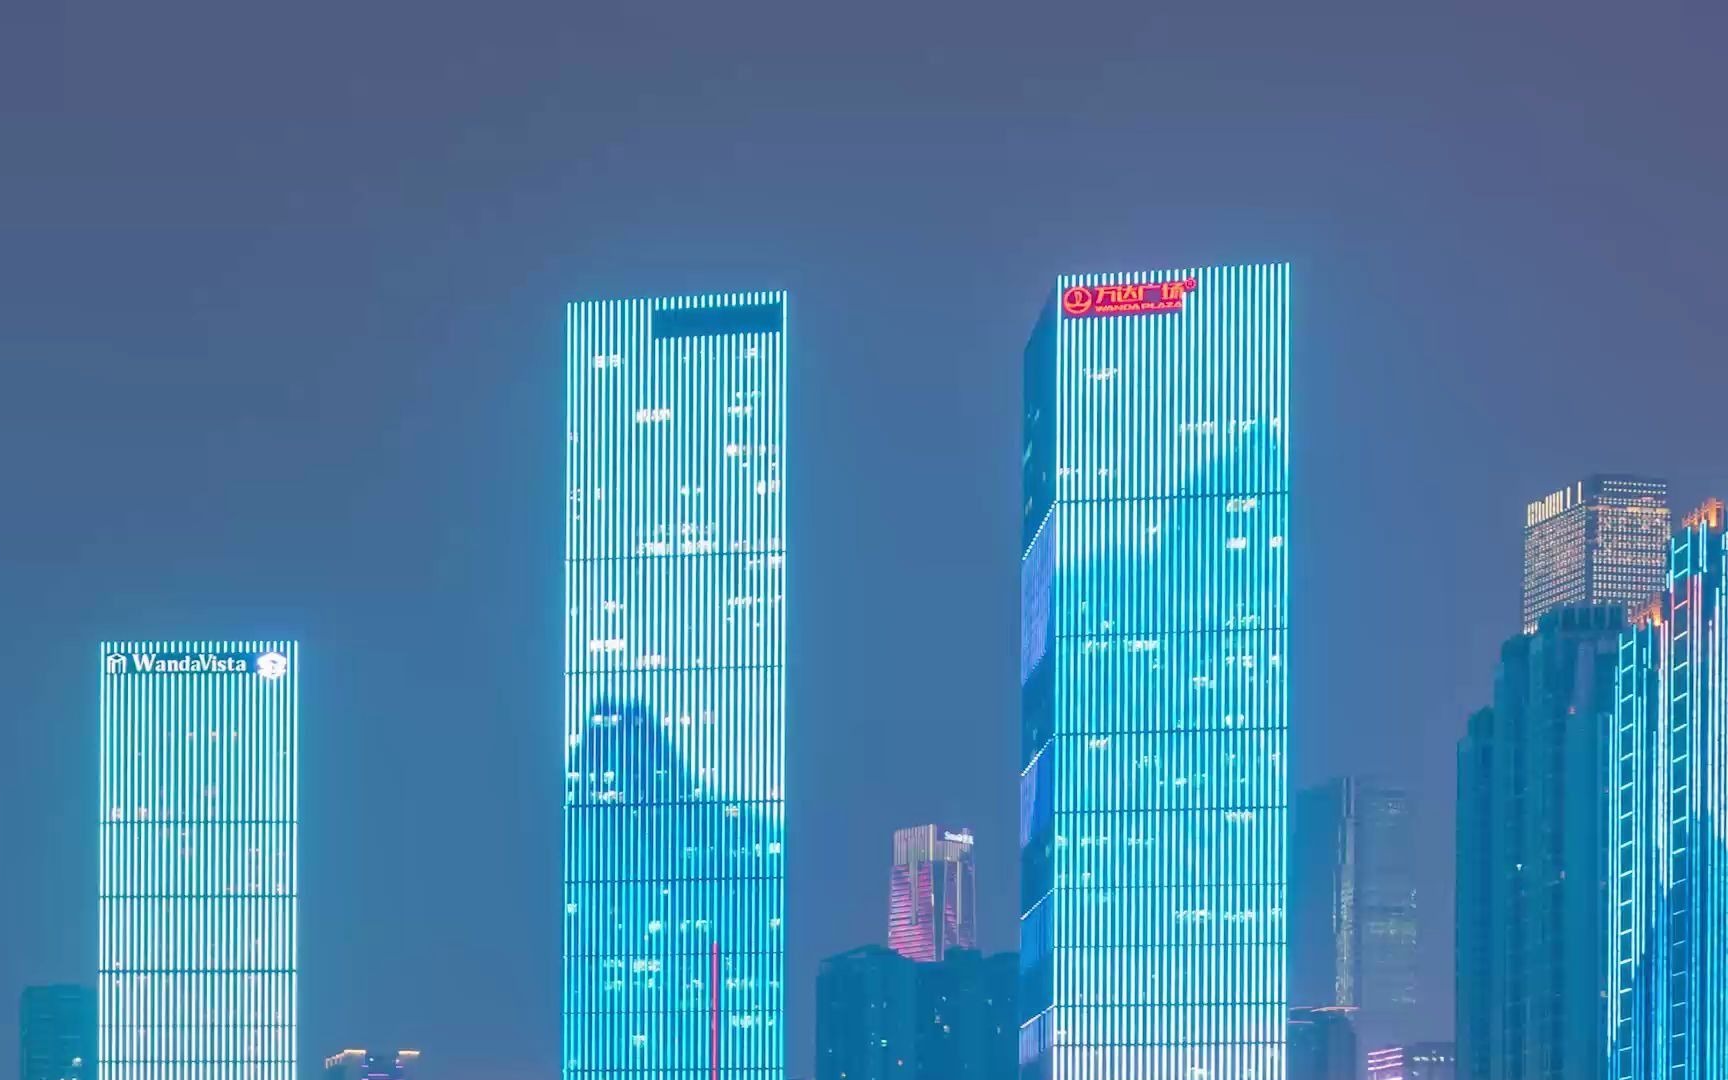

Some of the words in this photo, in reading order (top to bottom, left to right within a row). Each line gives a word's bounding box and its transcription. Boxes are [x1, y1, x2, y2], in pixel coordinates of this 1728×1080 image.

[1095, 281, 1186, 303] 万达广场
[1095, 304, 1140, 313] WANDA
[1141, 302, 1183, 310] PLAZA
[133, 653, 247, 672] WandaVista
